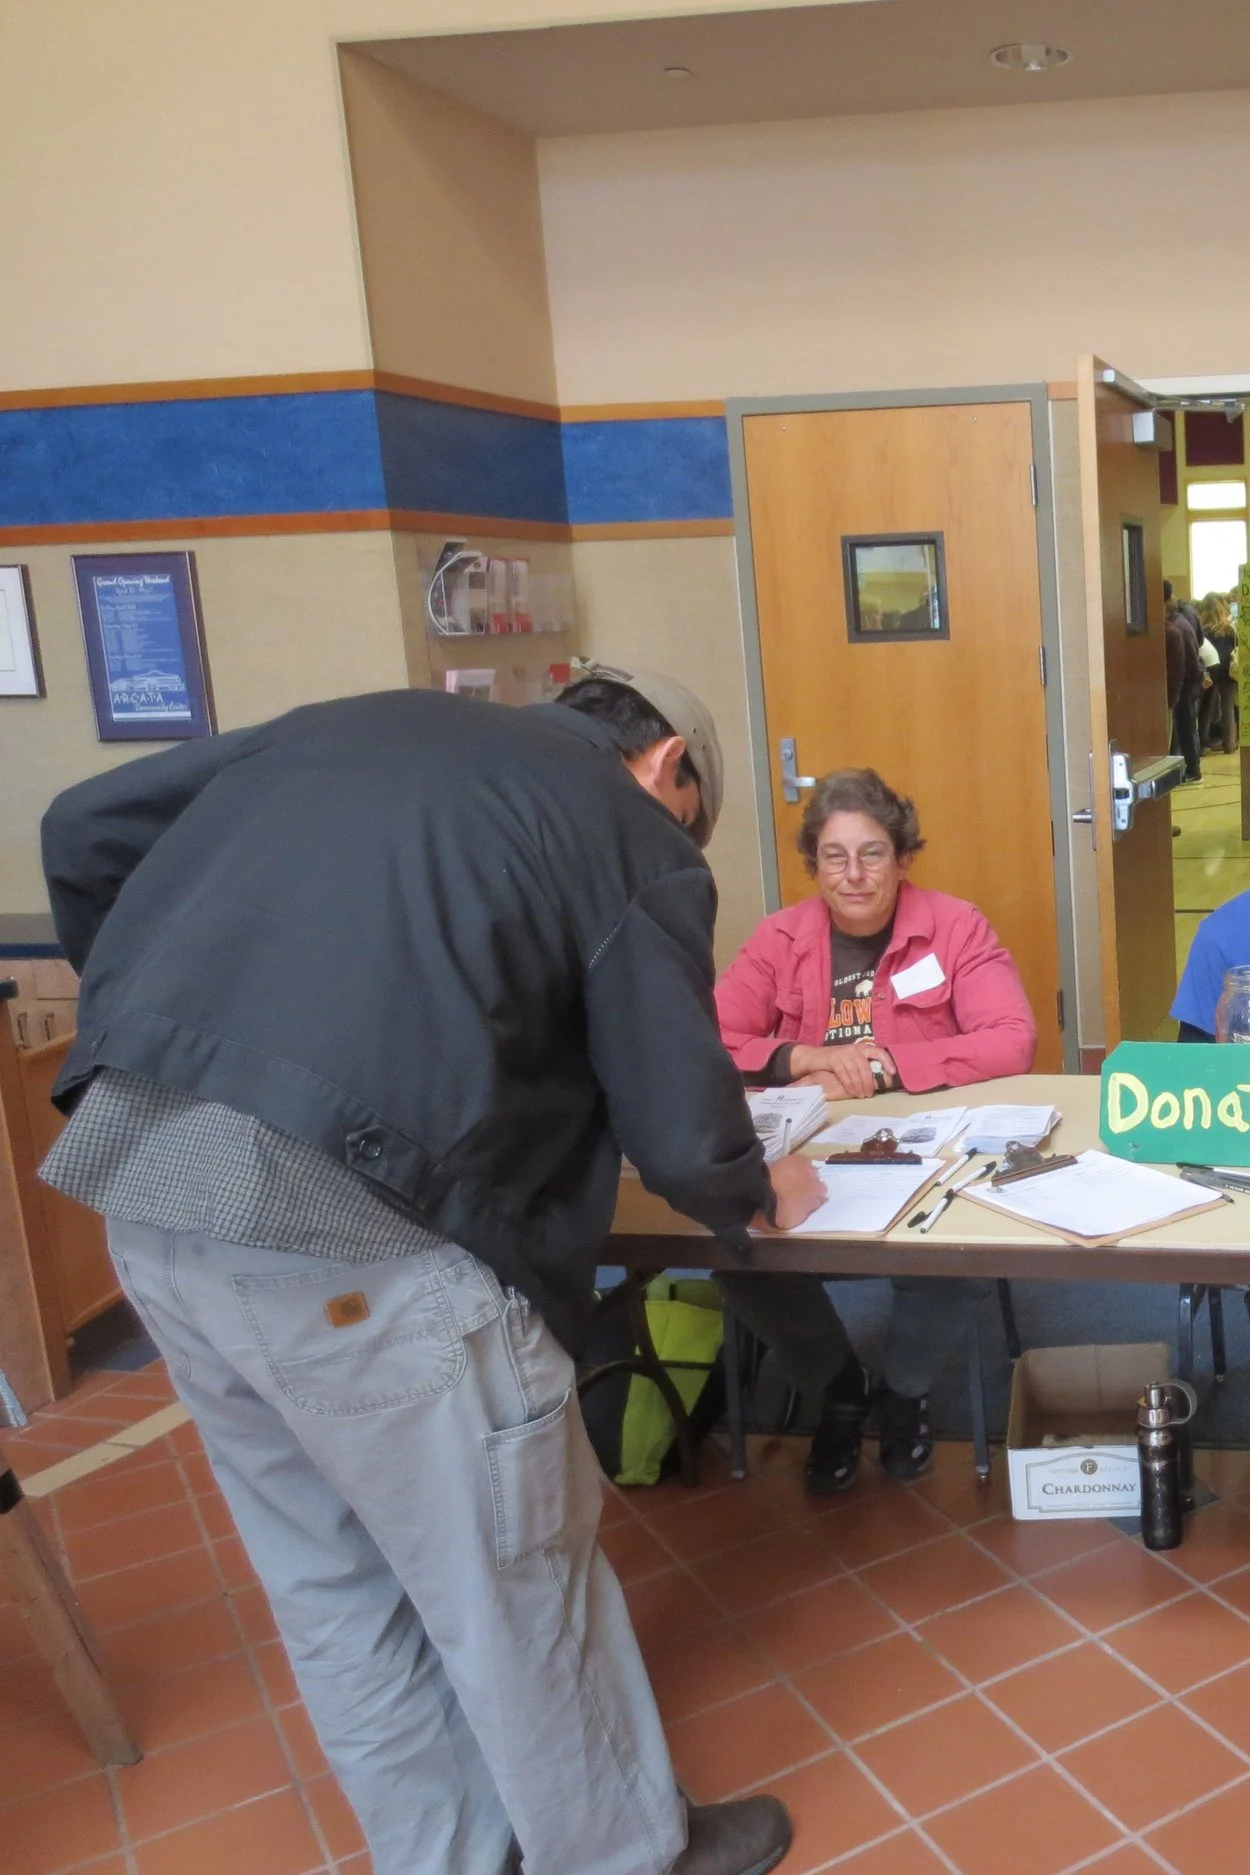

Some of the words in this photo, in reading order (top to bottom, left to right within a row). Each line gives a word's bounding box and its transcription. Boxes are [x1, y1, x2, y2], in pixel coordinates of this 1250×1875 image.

[118, 576, 144, 588] Opening
[834, 972, 862, 987] OLDEST
[1041, 1482, 1137, 1495] CHARDONNAY
